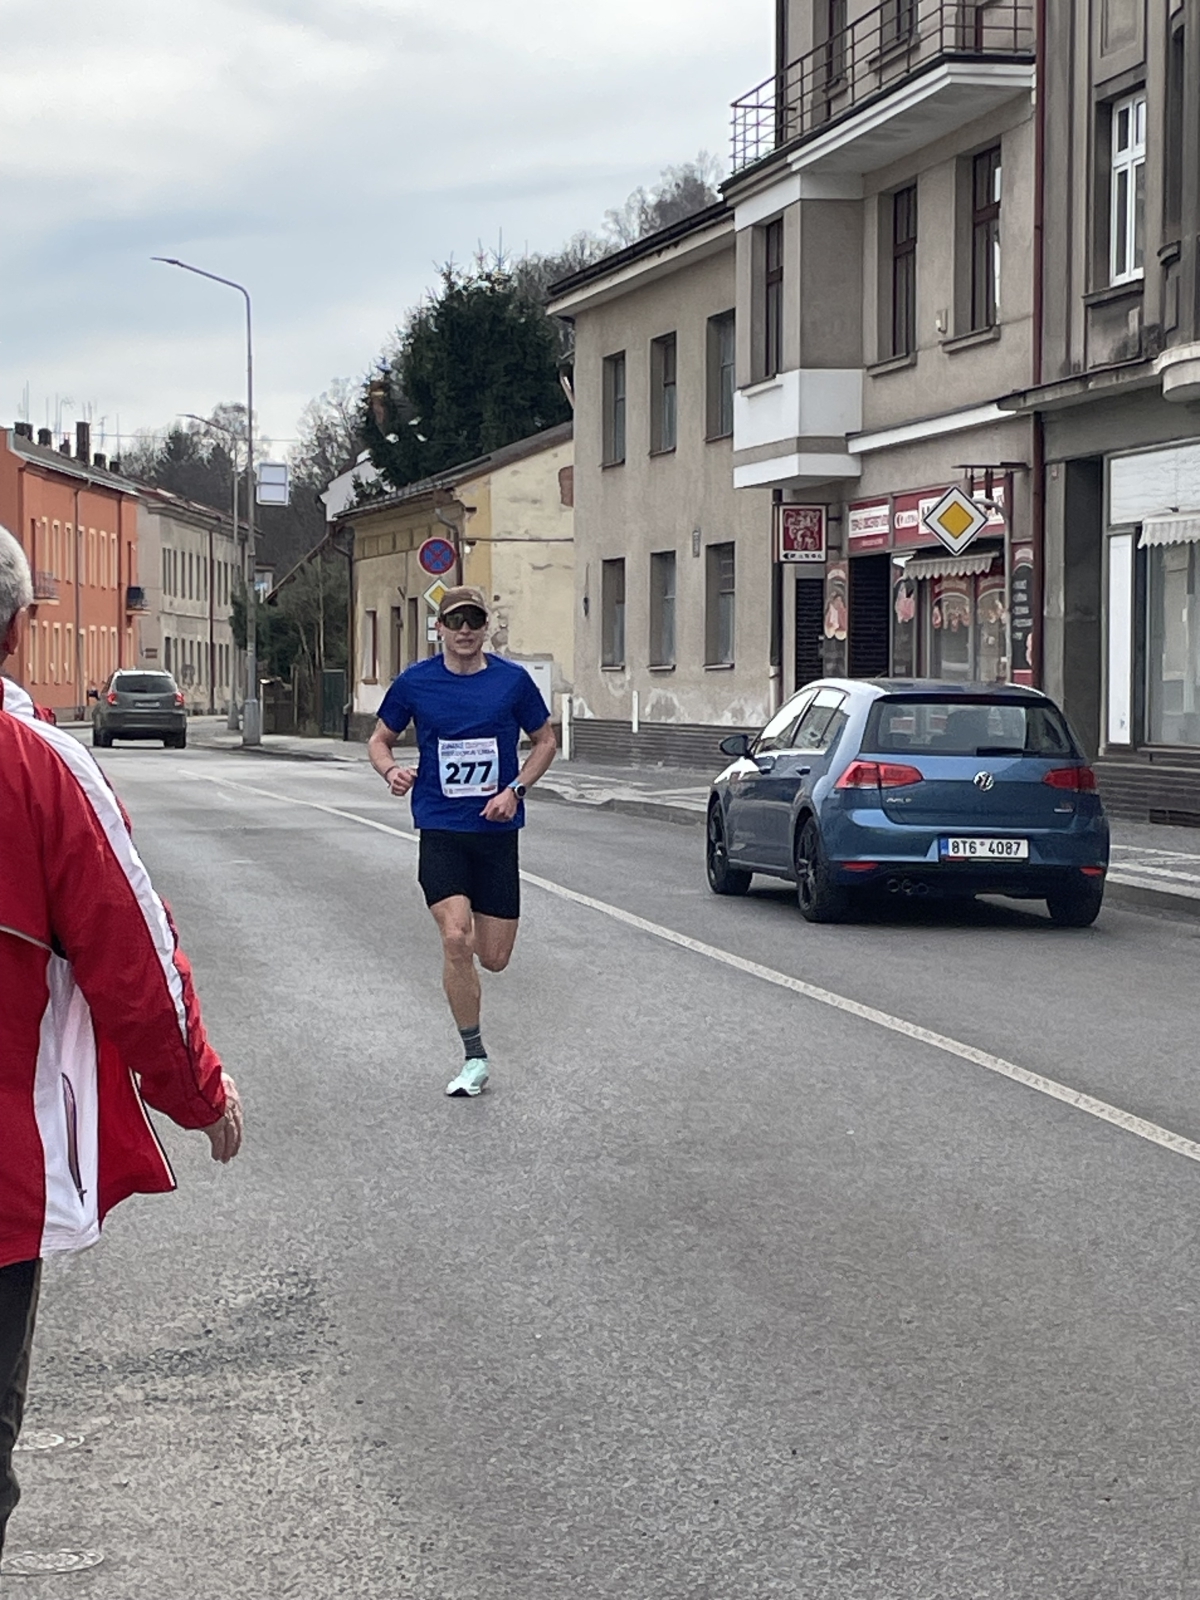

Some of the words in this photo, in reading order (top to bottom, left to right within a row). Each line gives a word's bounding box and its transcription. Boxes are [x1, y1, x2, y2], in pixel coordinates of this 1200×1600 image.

[445, 761, 493, 785] 277
[951, 840, 977, 855] 8T6
[988, 840, 1021, 856] 4087
